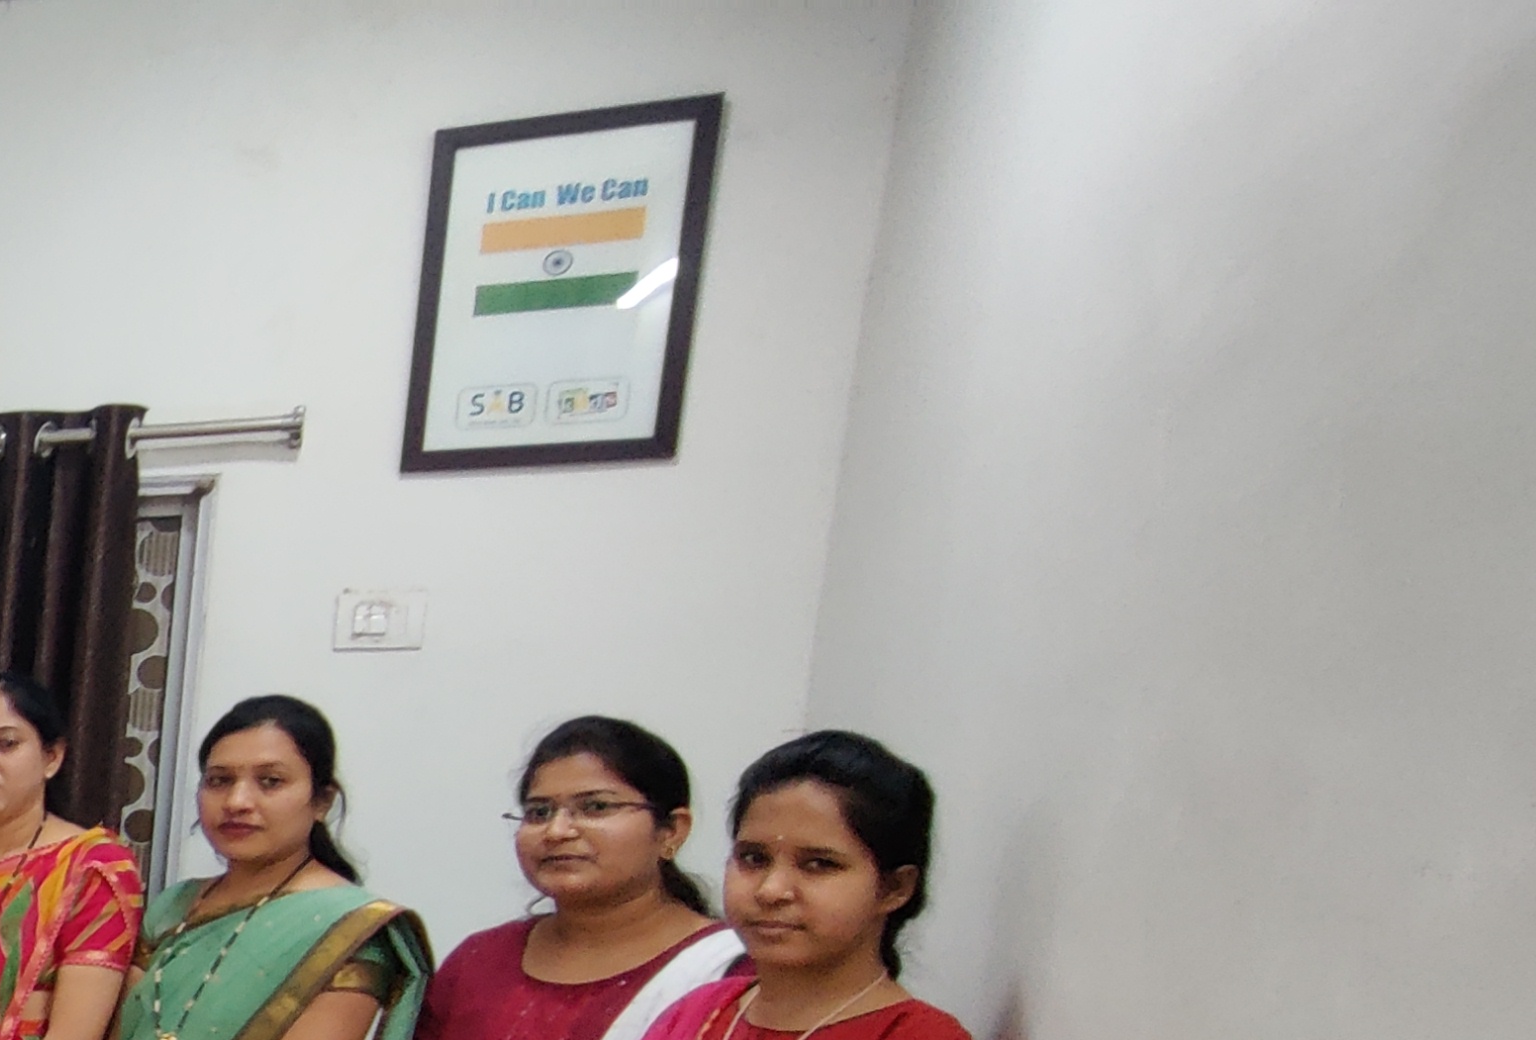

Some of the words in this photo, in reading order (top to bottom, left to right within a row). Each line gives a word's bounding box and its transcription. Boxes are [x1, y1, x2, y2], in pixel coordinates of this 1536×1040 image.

[486, 193, 496, 214] I
[501, 189, 546, 212] Can
[556, 182, 596, 206] We
[600, 178, 649, 201] Can
